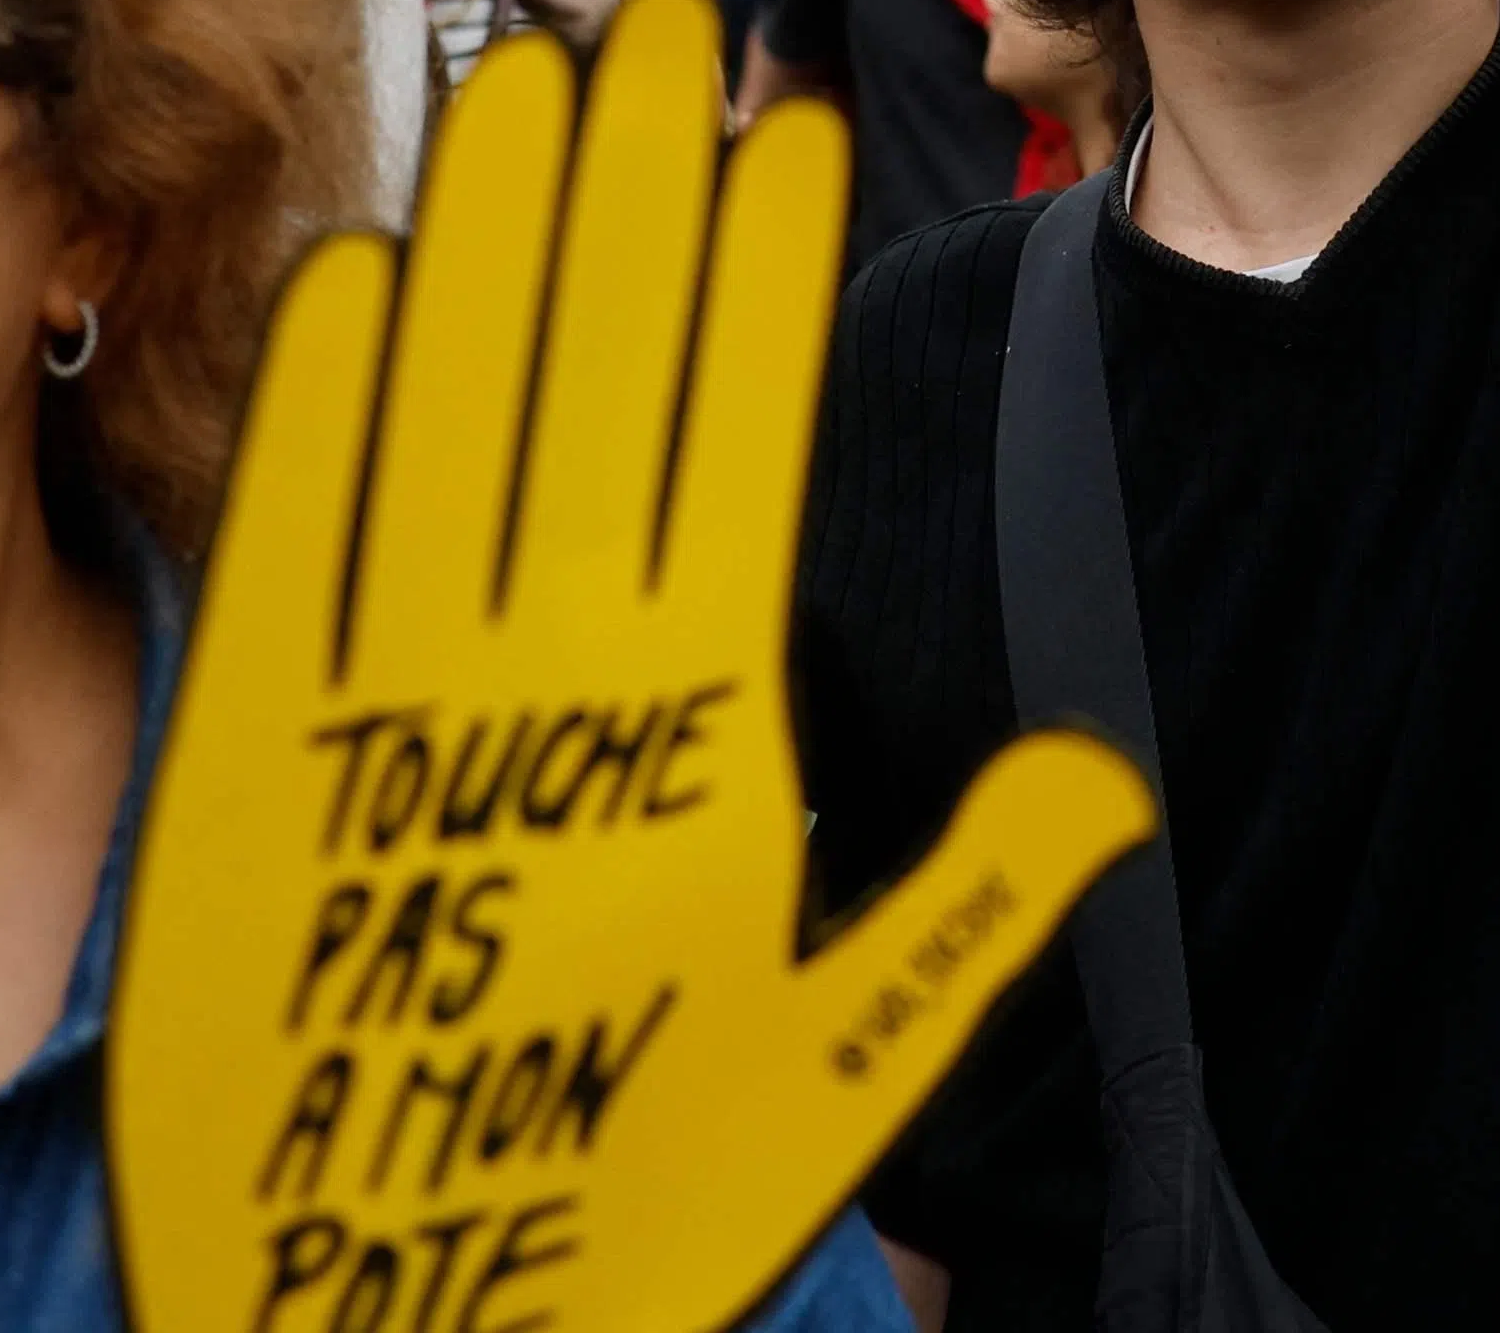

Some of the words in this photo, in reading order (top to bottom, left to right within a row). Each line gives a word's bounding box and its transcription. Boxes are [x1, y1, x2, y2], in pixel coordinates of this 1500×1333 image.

[308, 681, 740, 859] TOUCHE
[284, 875, 518, 1037] PAS
[252, 1047, 358, 1207] A
[366, 979, 678, 1197] MON
[248, 1193, 586, 1333] POTE
